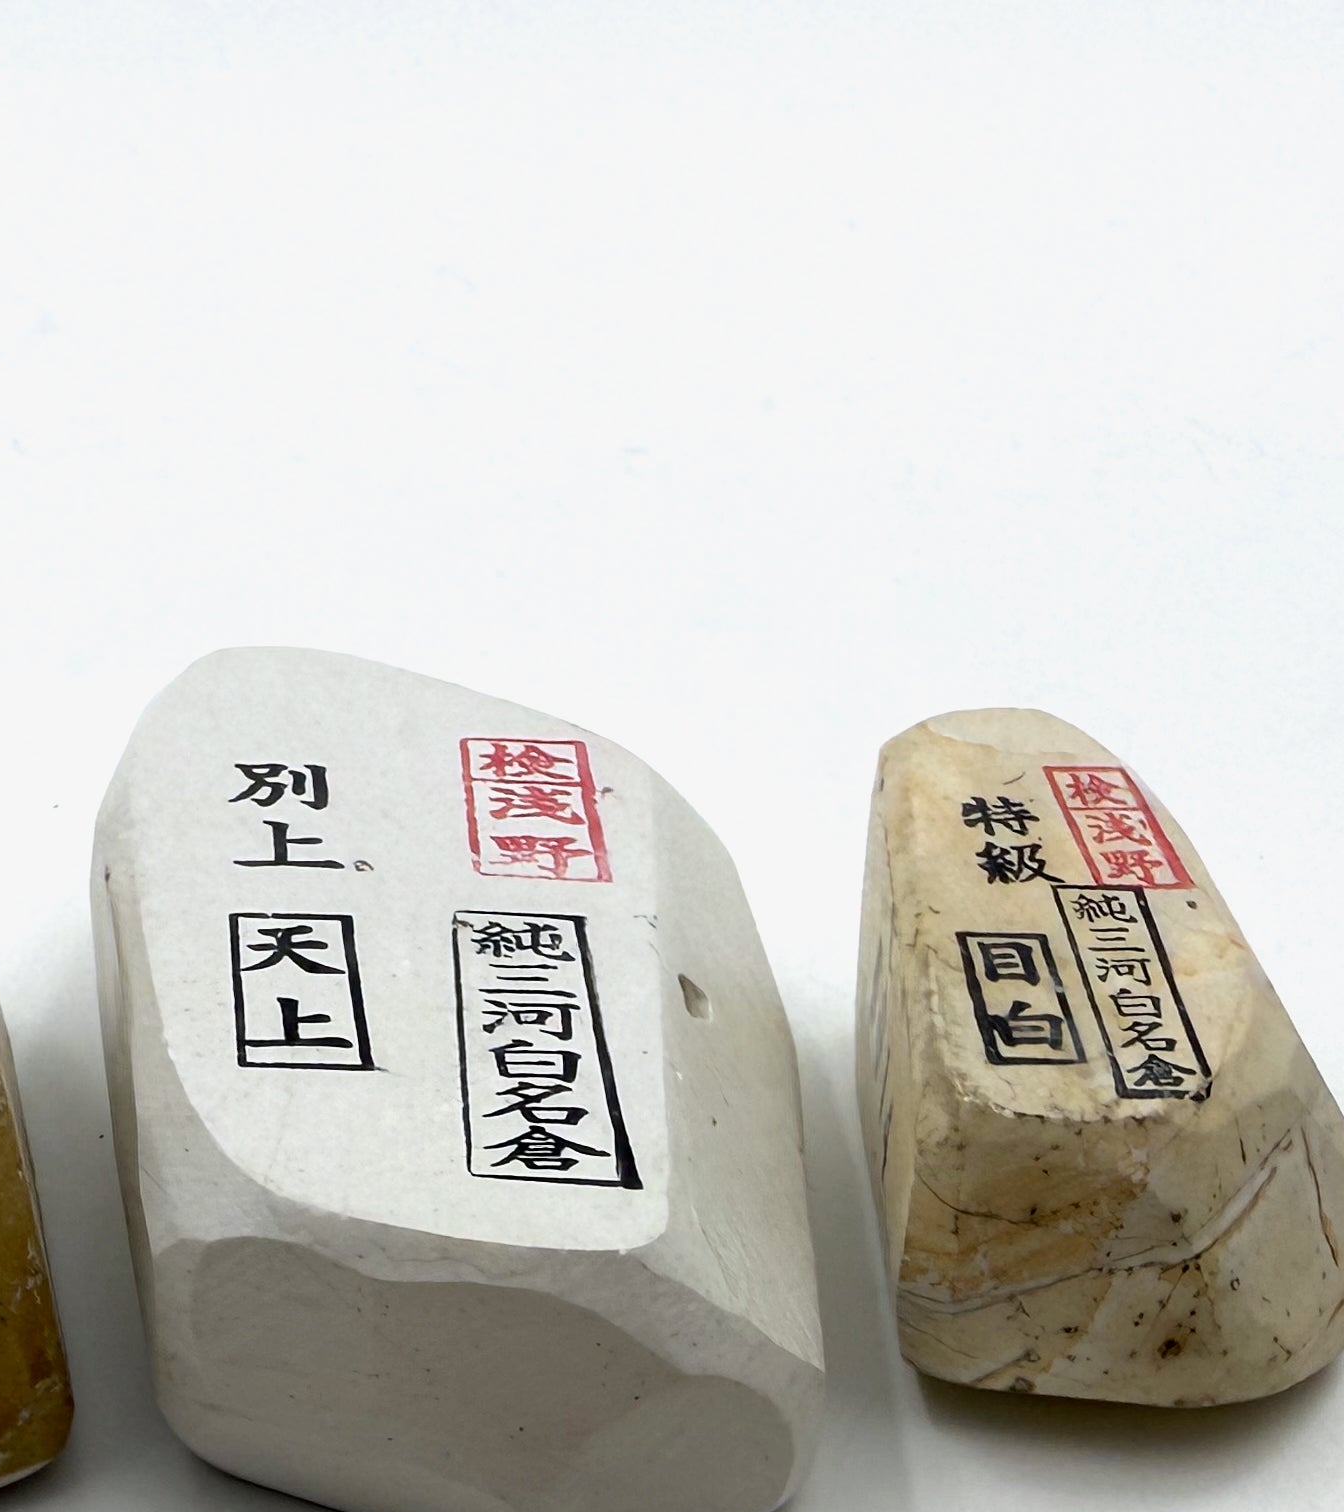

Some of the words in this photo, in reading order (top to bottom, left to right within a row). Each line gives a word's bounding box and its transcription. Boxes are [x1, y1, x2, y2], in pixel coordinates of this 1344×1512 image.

[228, 763, 346, 869] 別上
[961, 796, 1066, 884] 特級
[241, 925, 354, 1048] 天上
[472, 921, 611, 1172] 純三河白名倉
[1071, 893, 1196, 1087] 純三河白名倉
